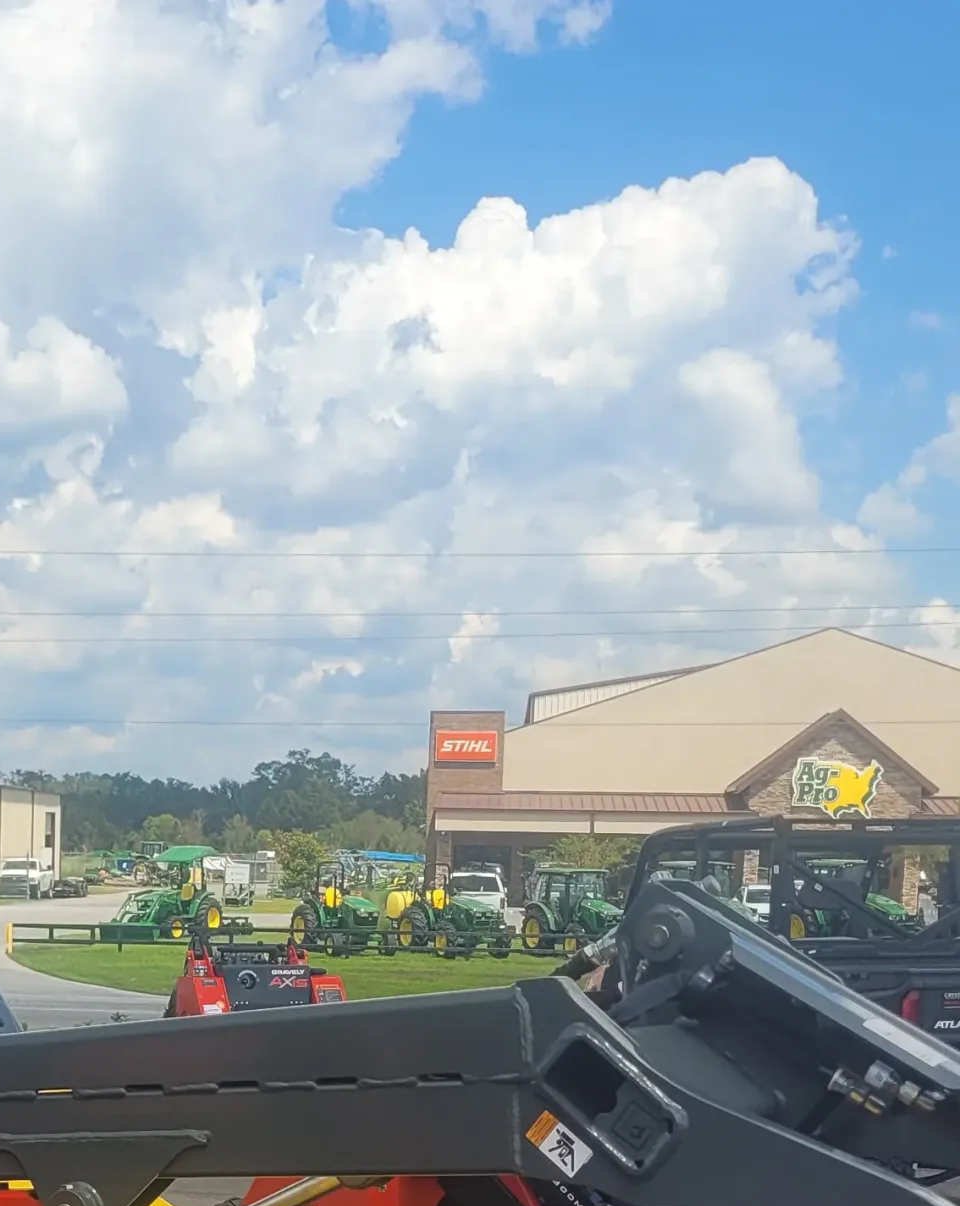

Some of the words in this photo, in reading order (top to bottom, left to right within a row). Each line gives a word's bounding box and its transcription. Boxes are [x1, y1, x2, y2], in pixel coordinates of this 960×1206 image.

[440, 740, 492, 752] STIHL
[797, 761, 838, 786] Ag-
[796, 783, 838, 803] Pro
[269, 976, 309, 989] AXIS
